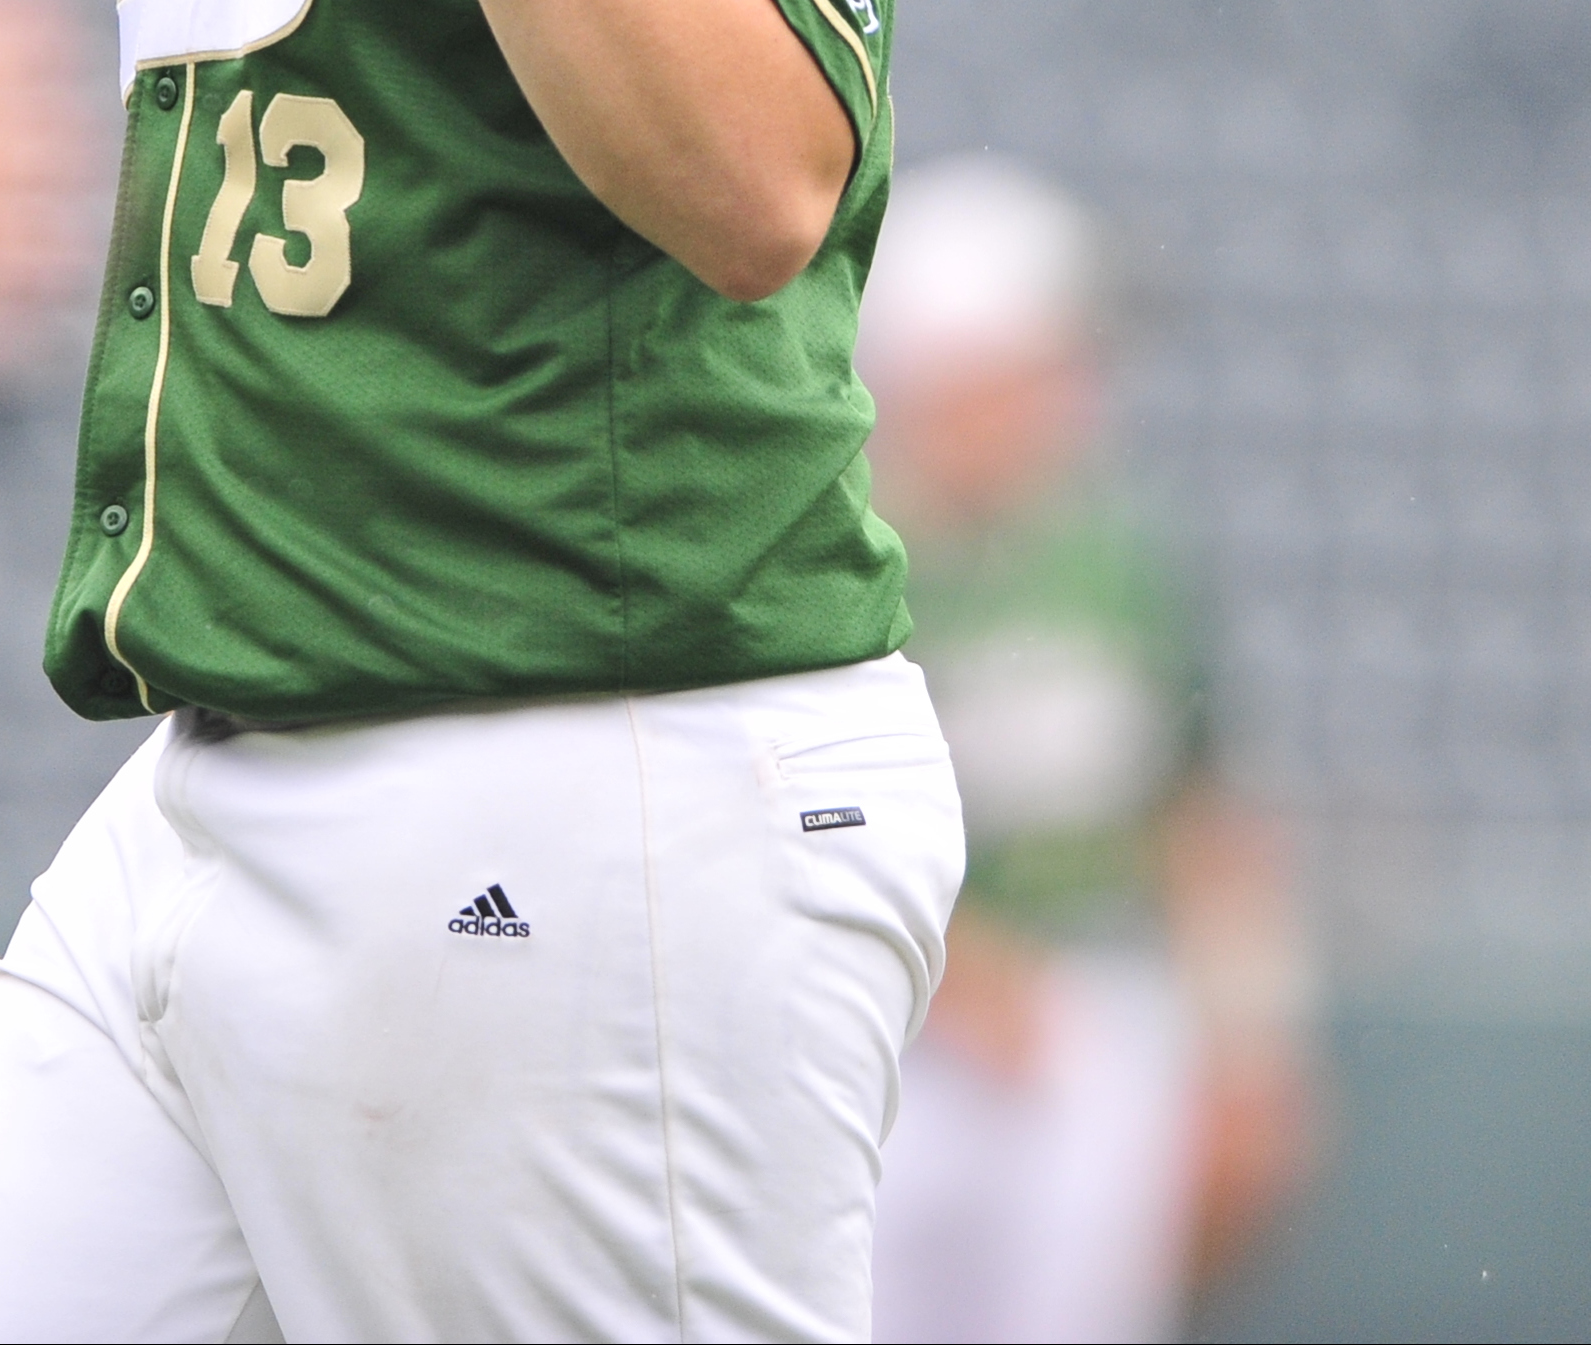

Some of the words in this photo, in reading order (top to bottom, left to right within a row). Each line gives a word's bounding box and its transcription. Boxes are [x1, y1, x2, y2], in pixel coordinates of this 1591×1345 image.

[191, 89, 366, 317] 13
[804, 810, 863, 827] CLIMALITE
[448, 915, 531, 937] adidas
